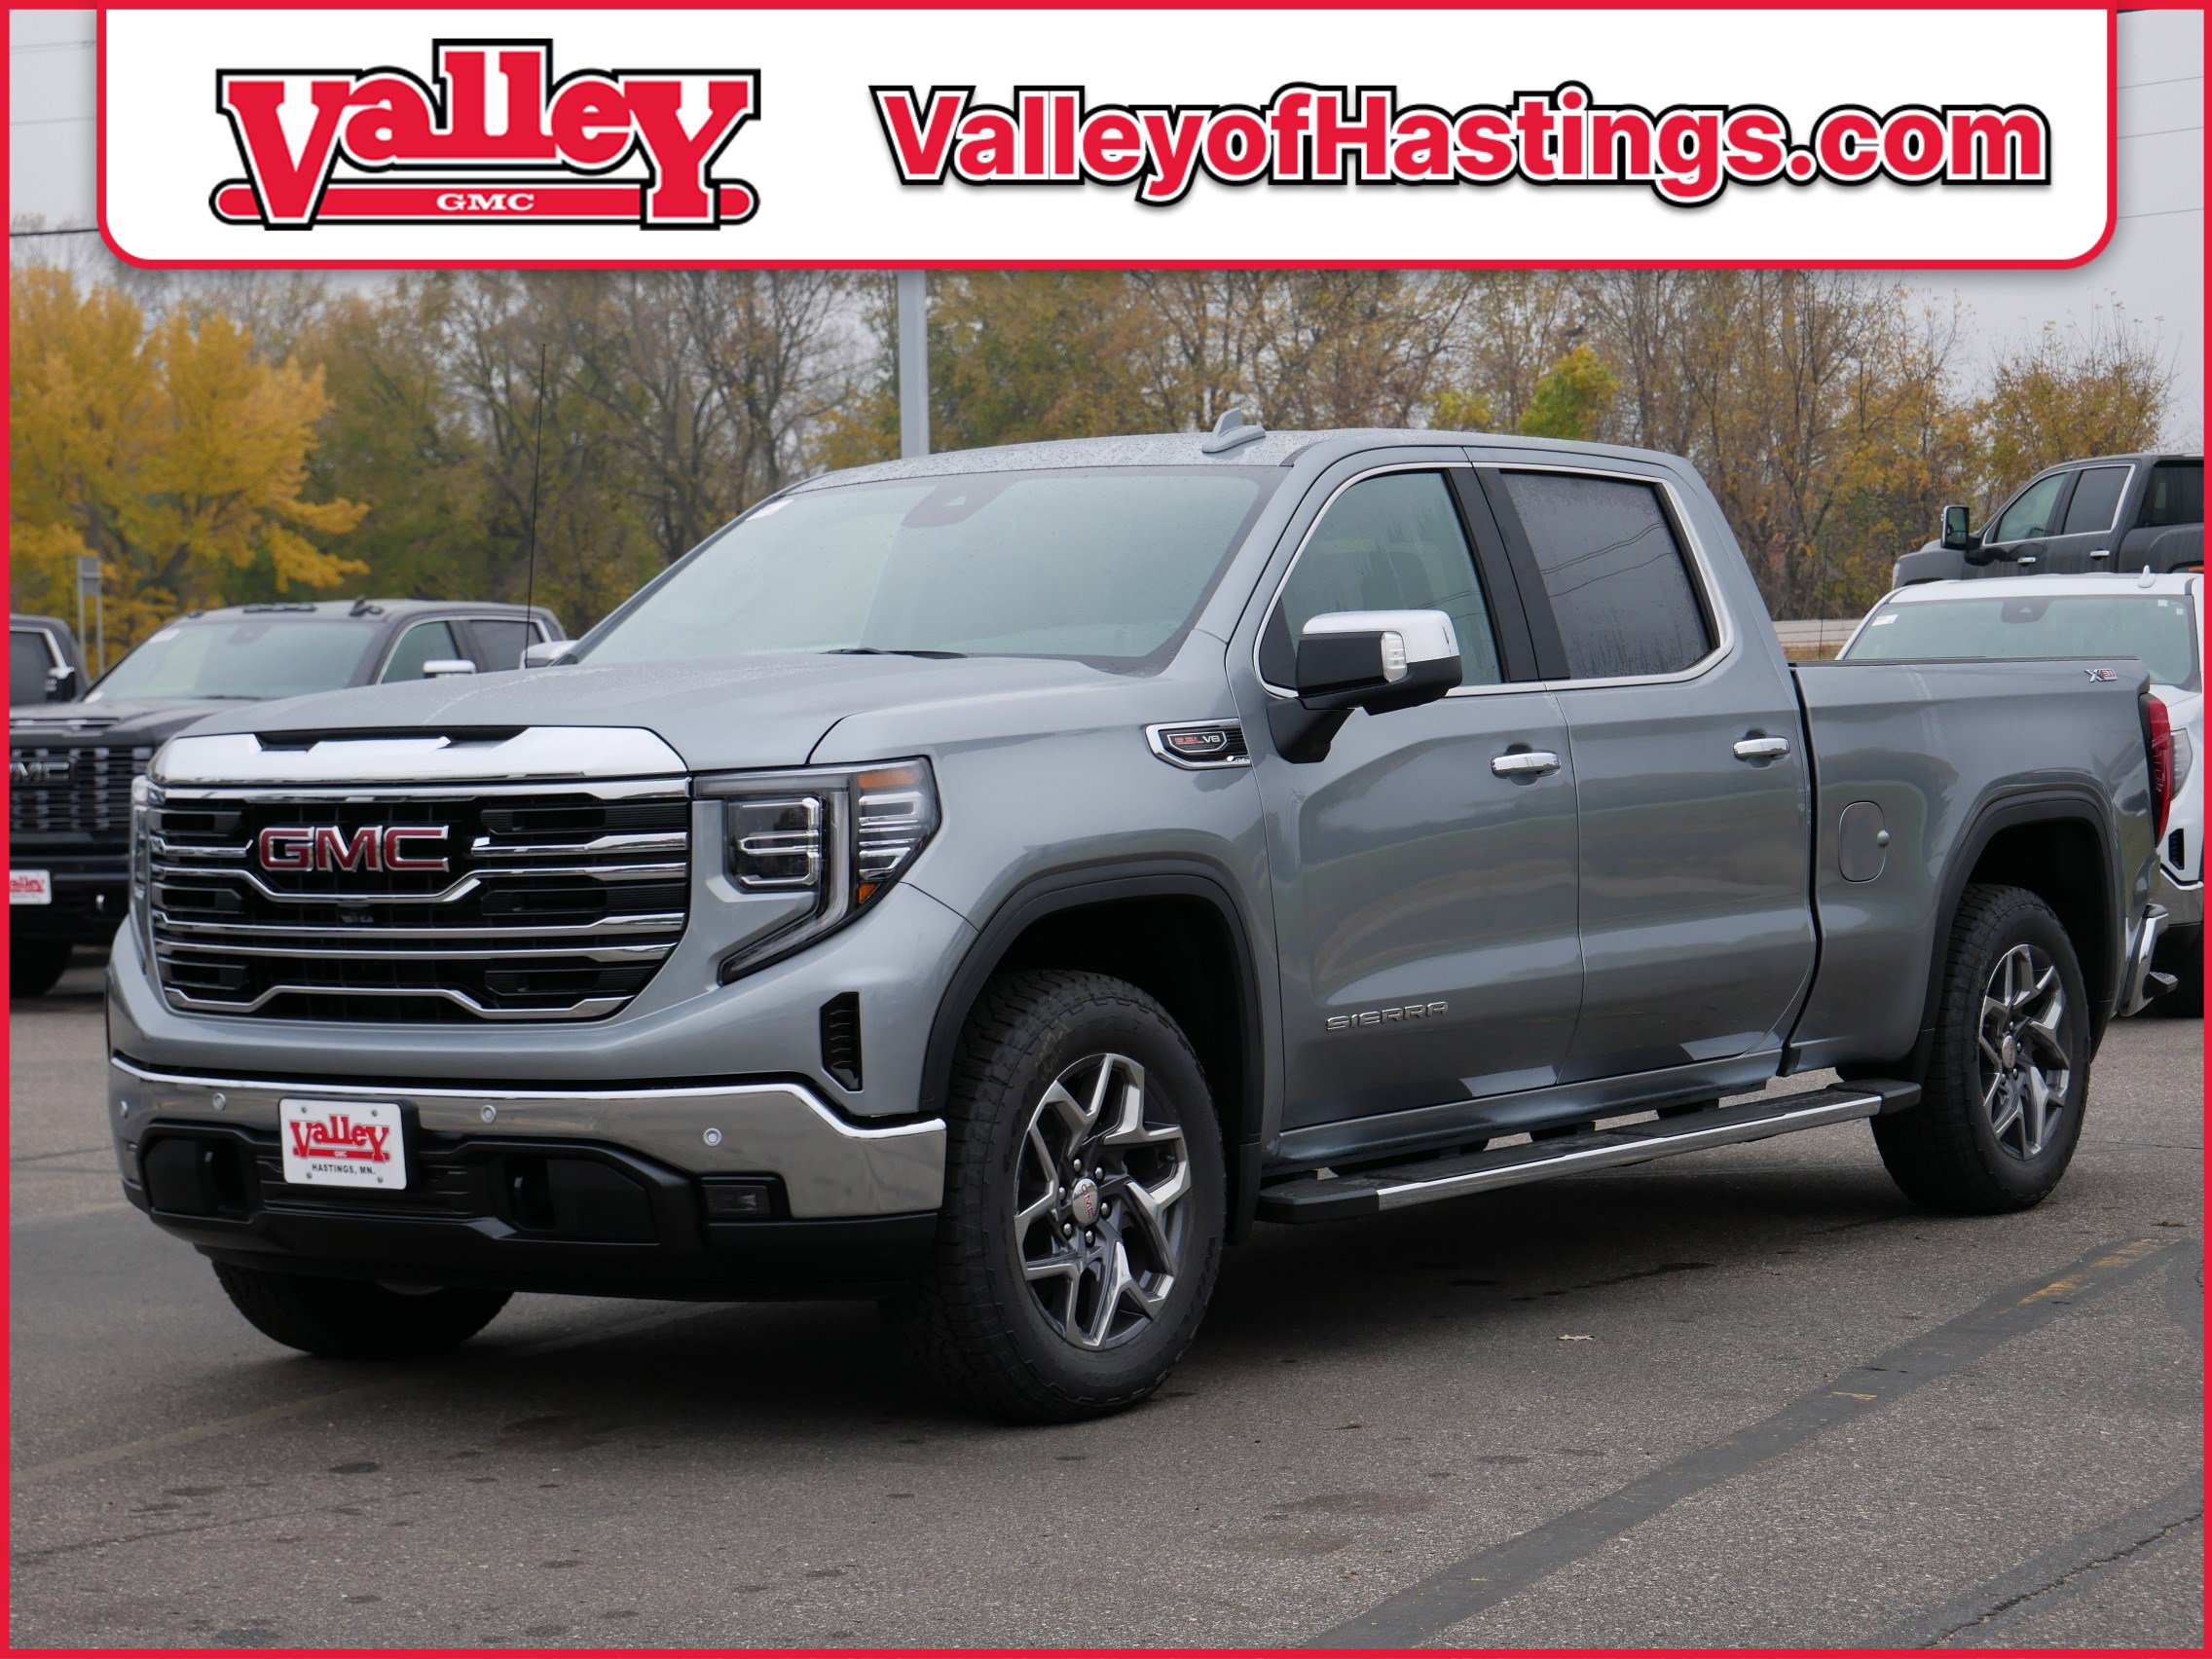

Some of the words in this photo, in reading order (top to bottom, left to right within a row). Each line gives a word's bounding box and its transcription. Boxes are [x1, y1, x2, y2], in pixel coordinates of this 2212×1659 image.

[10, 761, 69, 780] MC
[259, 826, 449, 872] GMC
[1326, 1001, 1449, 1031] SIERRA
[312, 1163, 357, 1174] HASTINGS,
